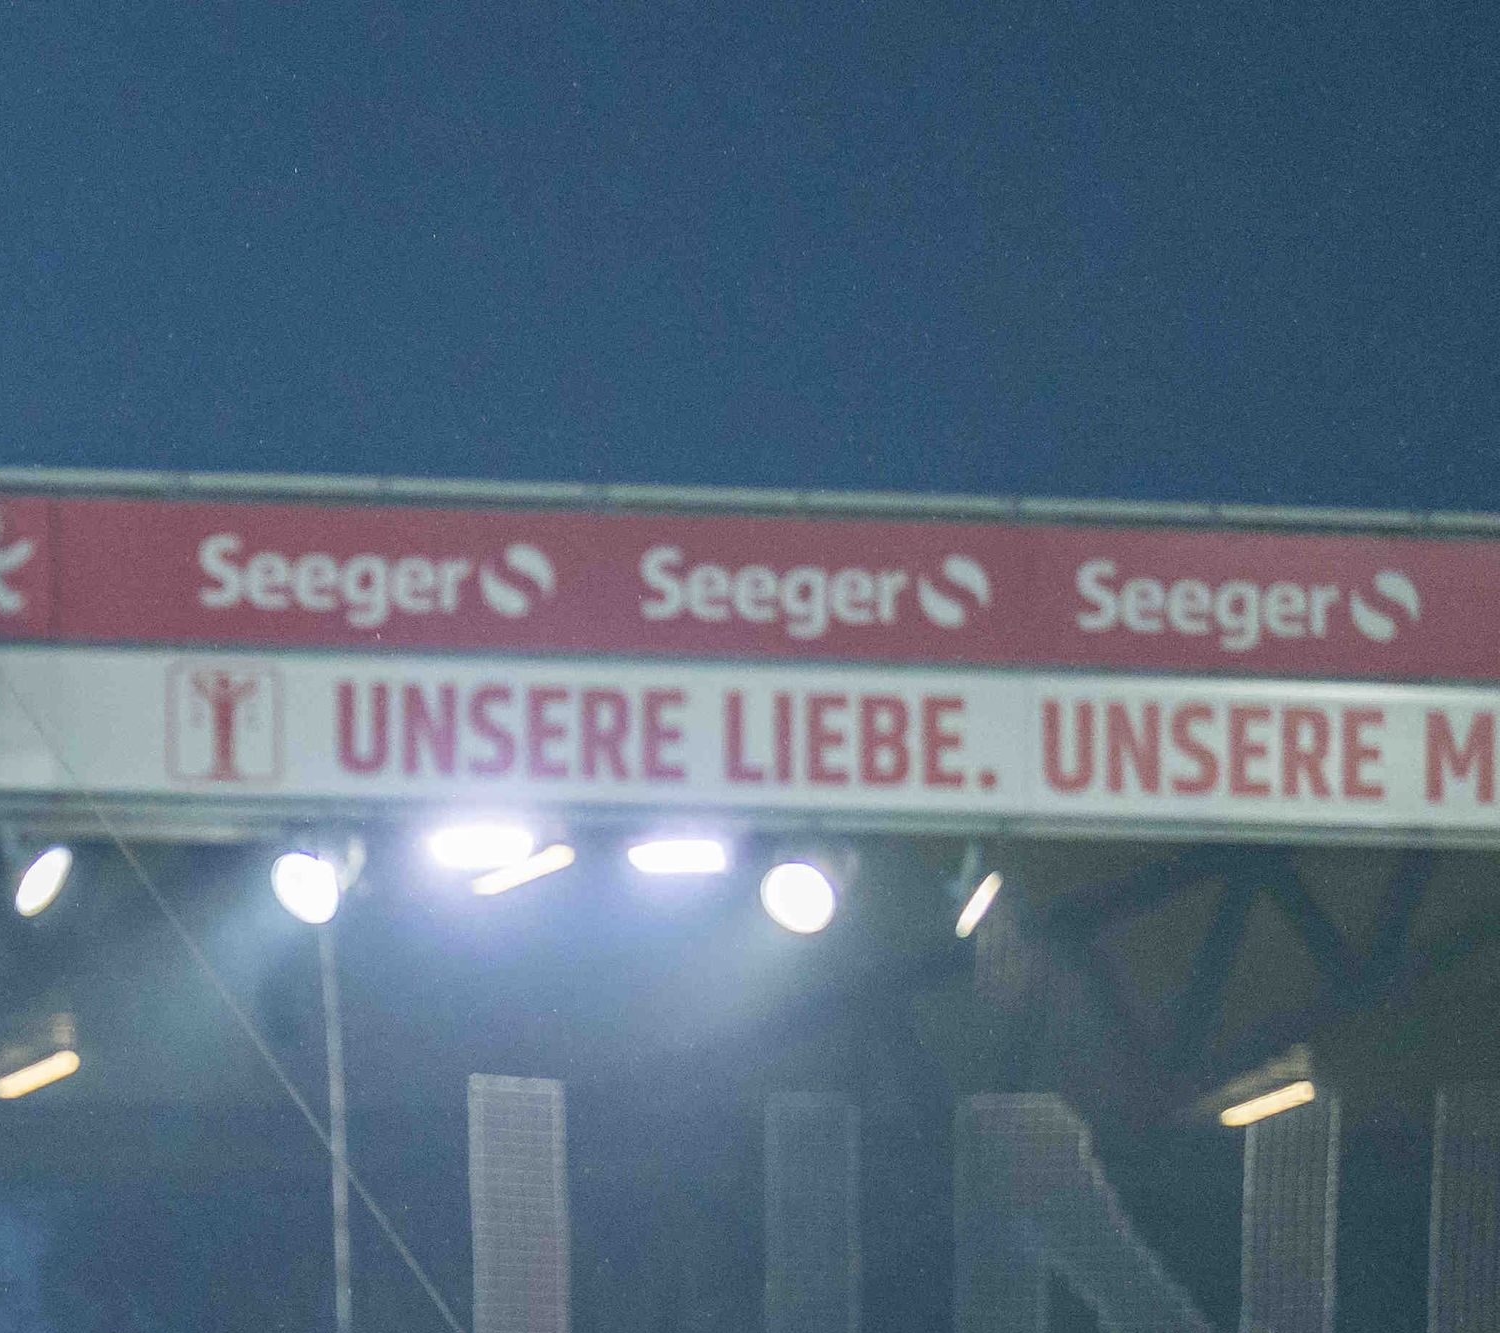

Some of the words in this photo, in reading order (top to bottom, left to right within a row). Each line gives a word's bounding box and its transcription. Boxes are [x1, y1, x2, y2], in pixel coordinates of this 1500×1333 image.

[198, 532, 473, 629] Seeger
[639, 545, 909, 641] Seeger
[1076, 558, 1341, 652] Seeger
[335, 681, 685, 782] UNSERE
[725, 692, 998, 790] LIEBE.
[1041, 700, 1386, 801] UNSERE
